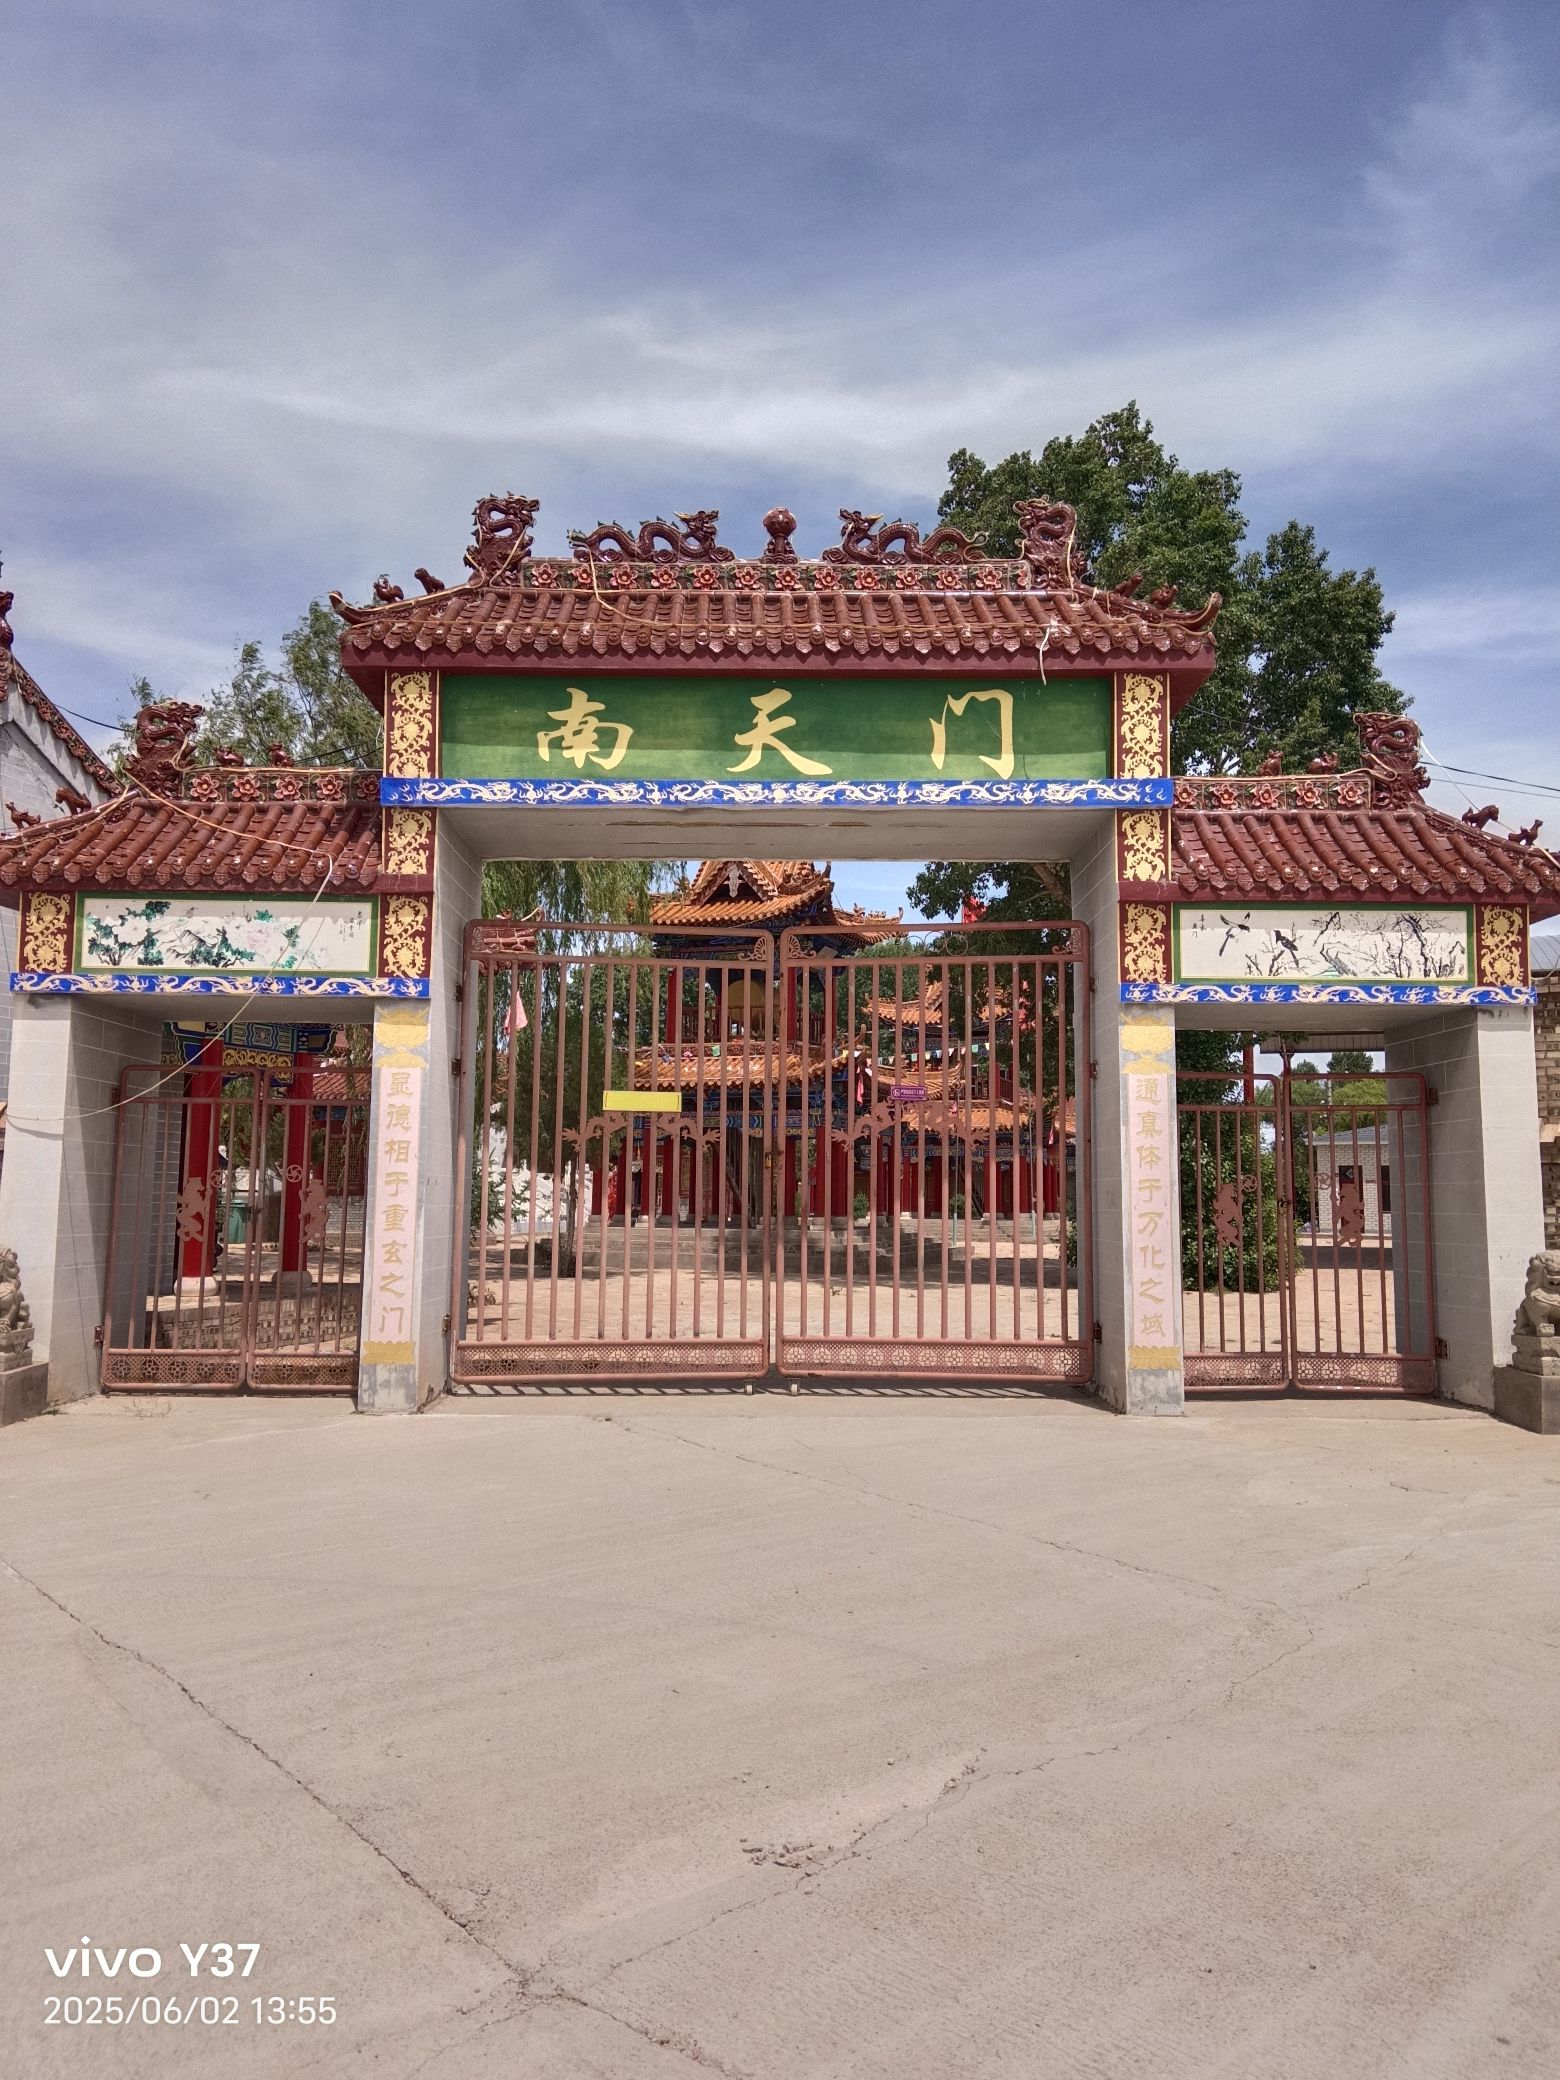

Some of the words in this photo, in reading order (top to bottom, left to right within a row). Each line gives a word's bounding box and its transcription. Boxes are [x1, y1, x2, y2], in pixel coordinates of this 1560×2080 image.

[537, 688, 1014, 780] 南天门
[379, 1071, 413, 1334] 显德相于重玄之门
[1135, 1077, 1167, 1338] 通真体于万化之域
